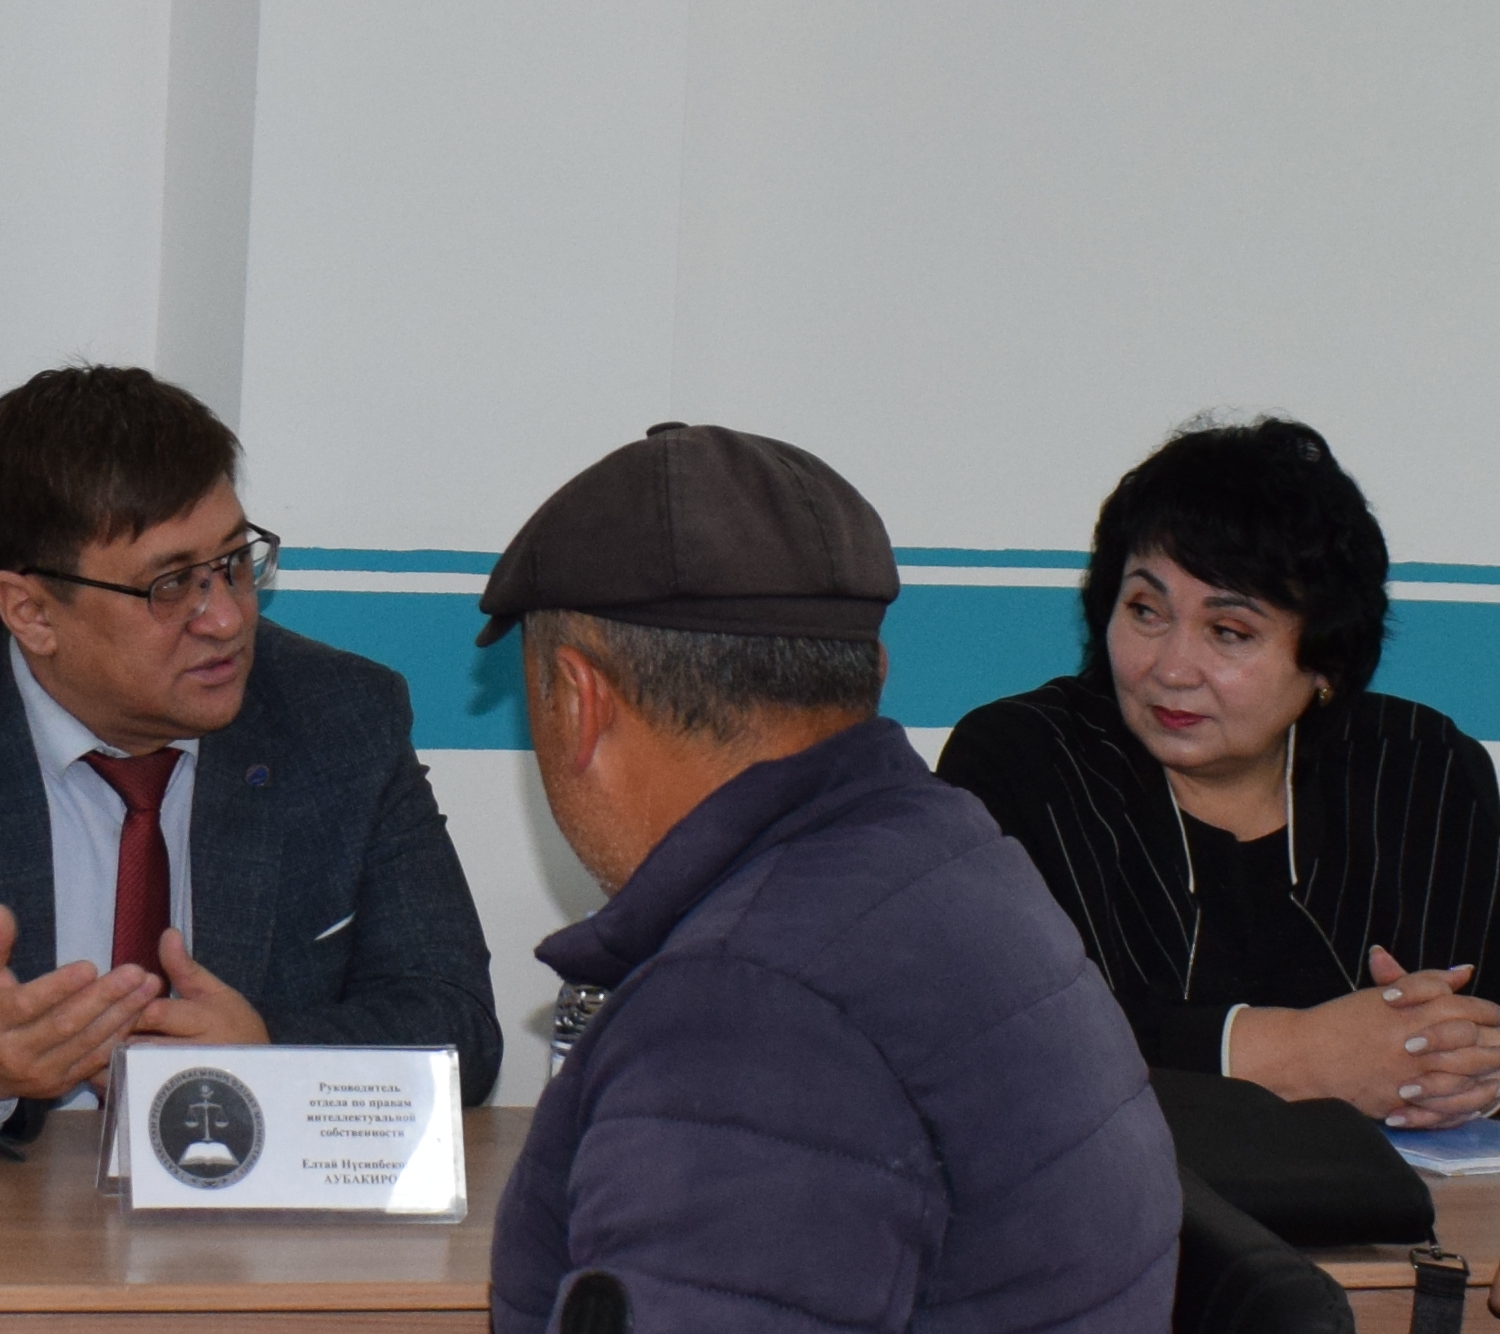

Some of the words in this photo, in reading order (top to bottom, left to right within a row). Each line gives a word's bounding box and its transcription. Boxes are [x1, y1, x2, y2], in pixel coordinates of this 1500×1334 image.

[318, 1082, 401, 1095] Руководитель
[309, 1098, 348, 1108] отдела
[351, 1099, 366, 1108] по
[369, 1100, 412, 1110] правам
[306, 1113, 416, 1124] интеллектуальной
[319, 1126, 405, 1138] собственности
[301, 1159, 338, 1169] Елтай
[342, 1159, 408, 1172] Нүсипбеко
[324, 1174, 398, 1185] АУБАКИРО
